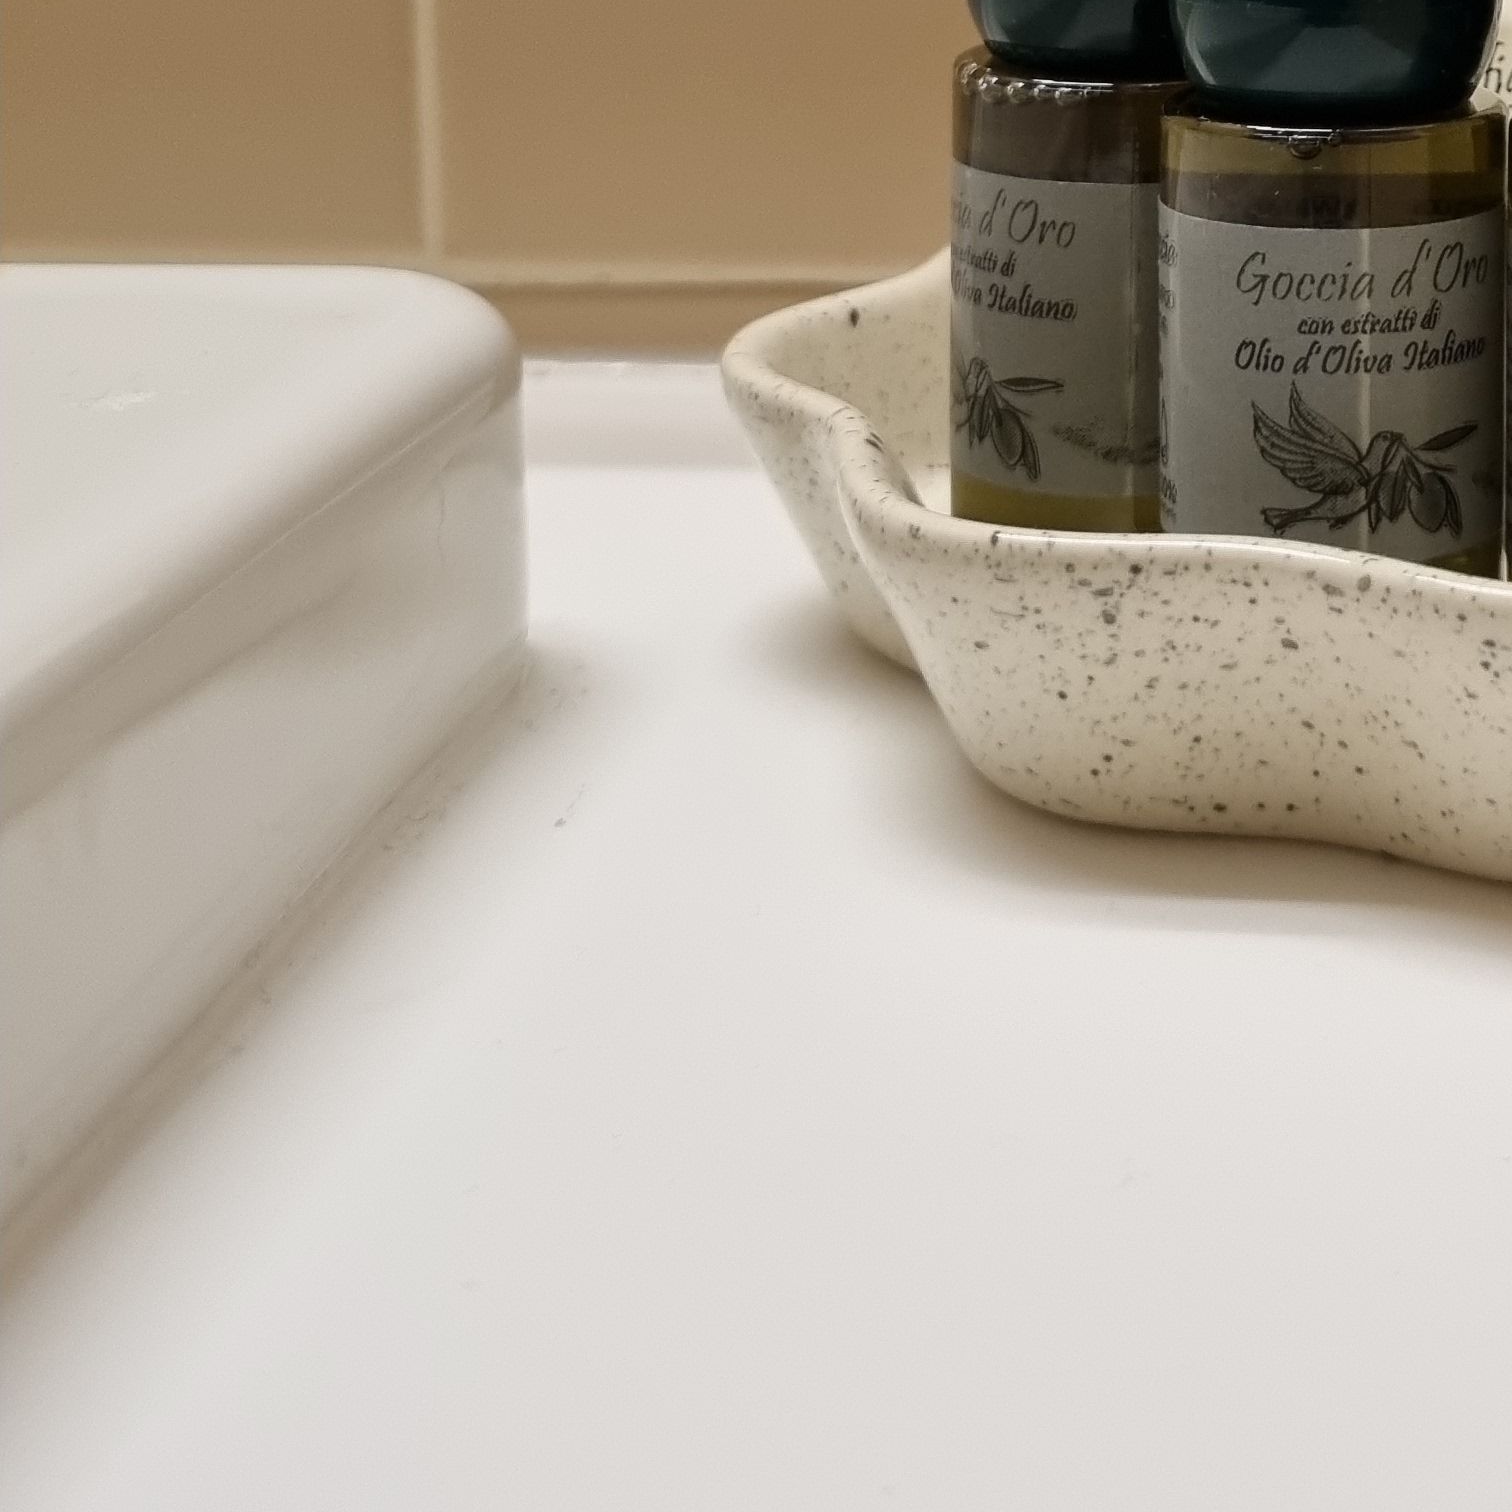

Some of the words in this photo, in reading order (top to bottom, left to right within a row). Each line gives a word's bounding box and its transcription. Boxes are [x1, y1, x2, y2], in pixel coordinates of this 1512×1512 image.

[978, 187, 1077, 249] d'Oro
[1000, 249, 1017, 278] di
[1236, 250, 1376, 307] Goccia
[1390, 238, 1489, 299] d'Oro
[987, 282, 1078, 322] Italiano
[1296, 316, 1336, 336] con
[1340, 305, 1418, 336] estratti
[1420, 298, 1441, 331] di
[1234, 336, 1285, 374] Olio
[1292, 338, 1394, 376] d'Oliva
[1403, 328, 1487, 372] Italiano
